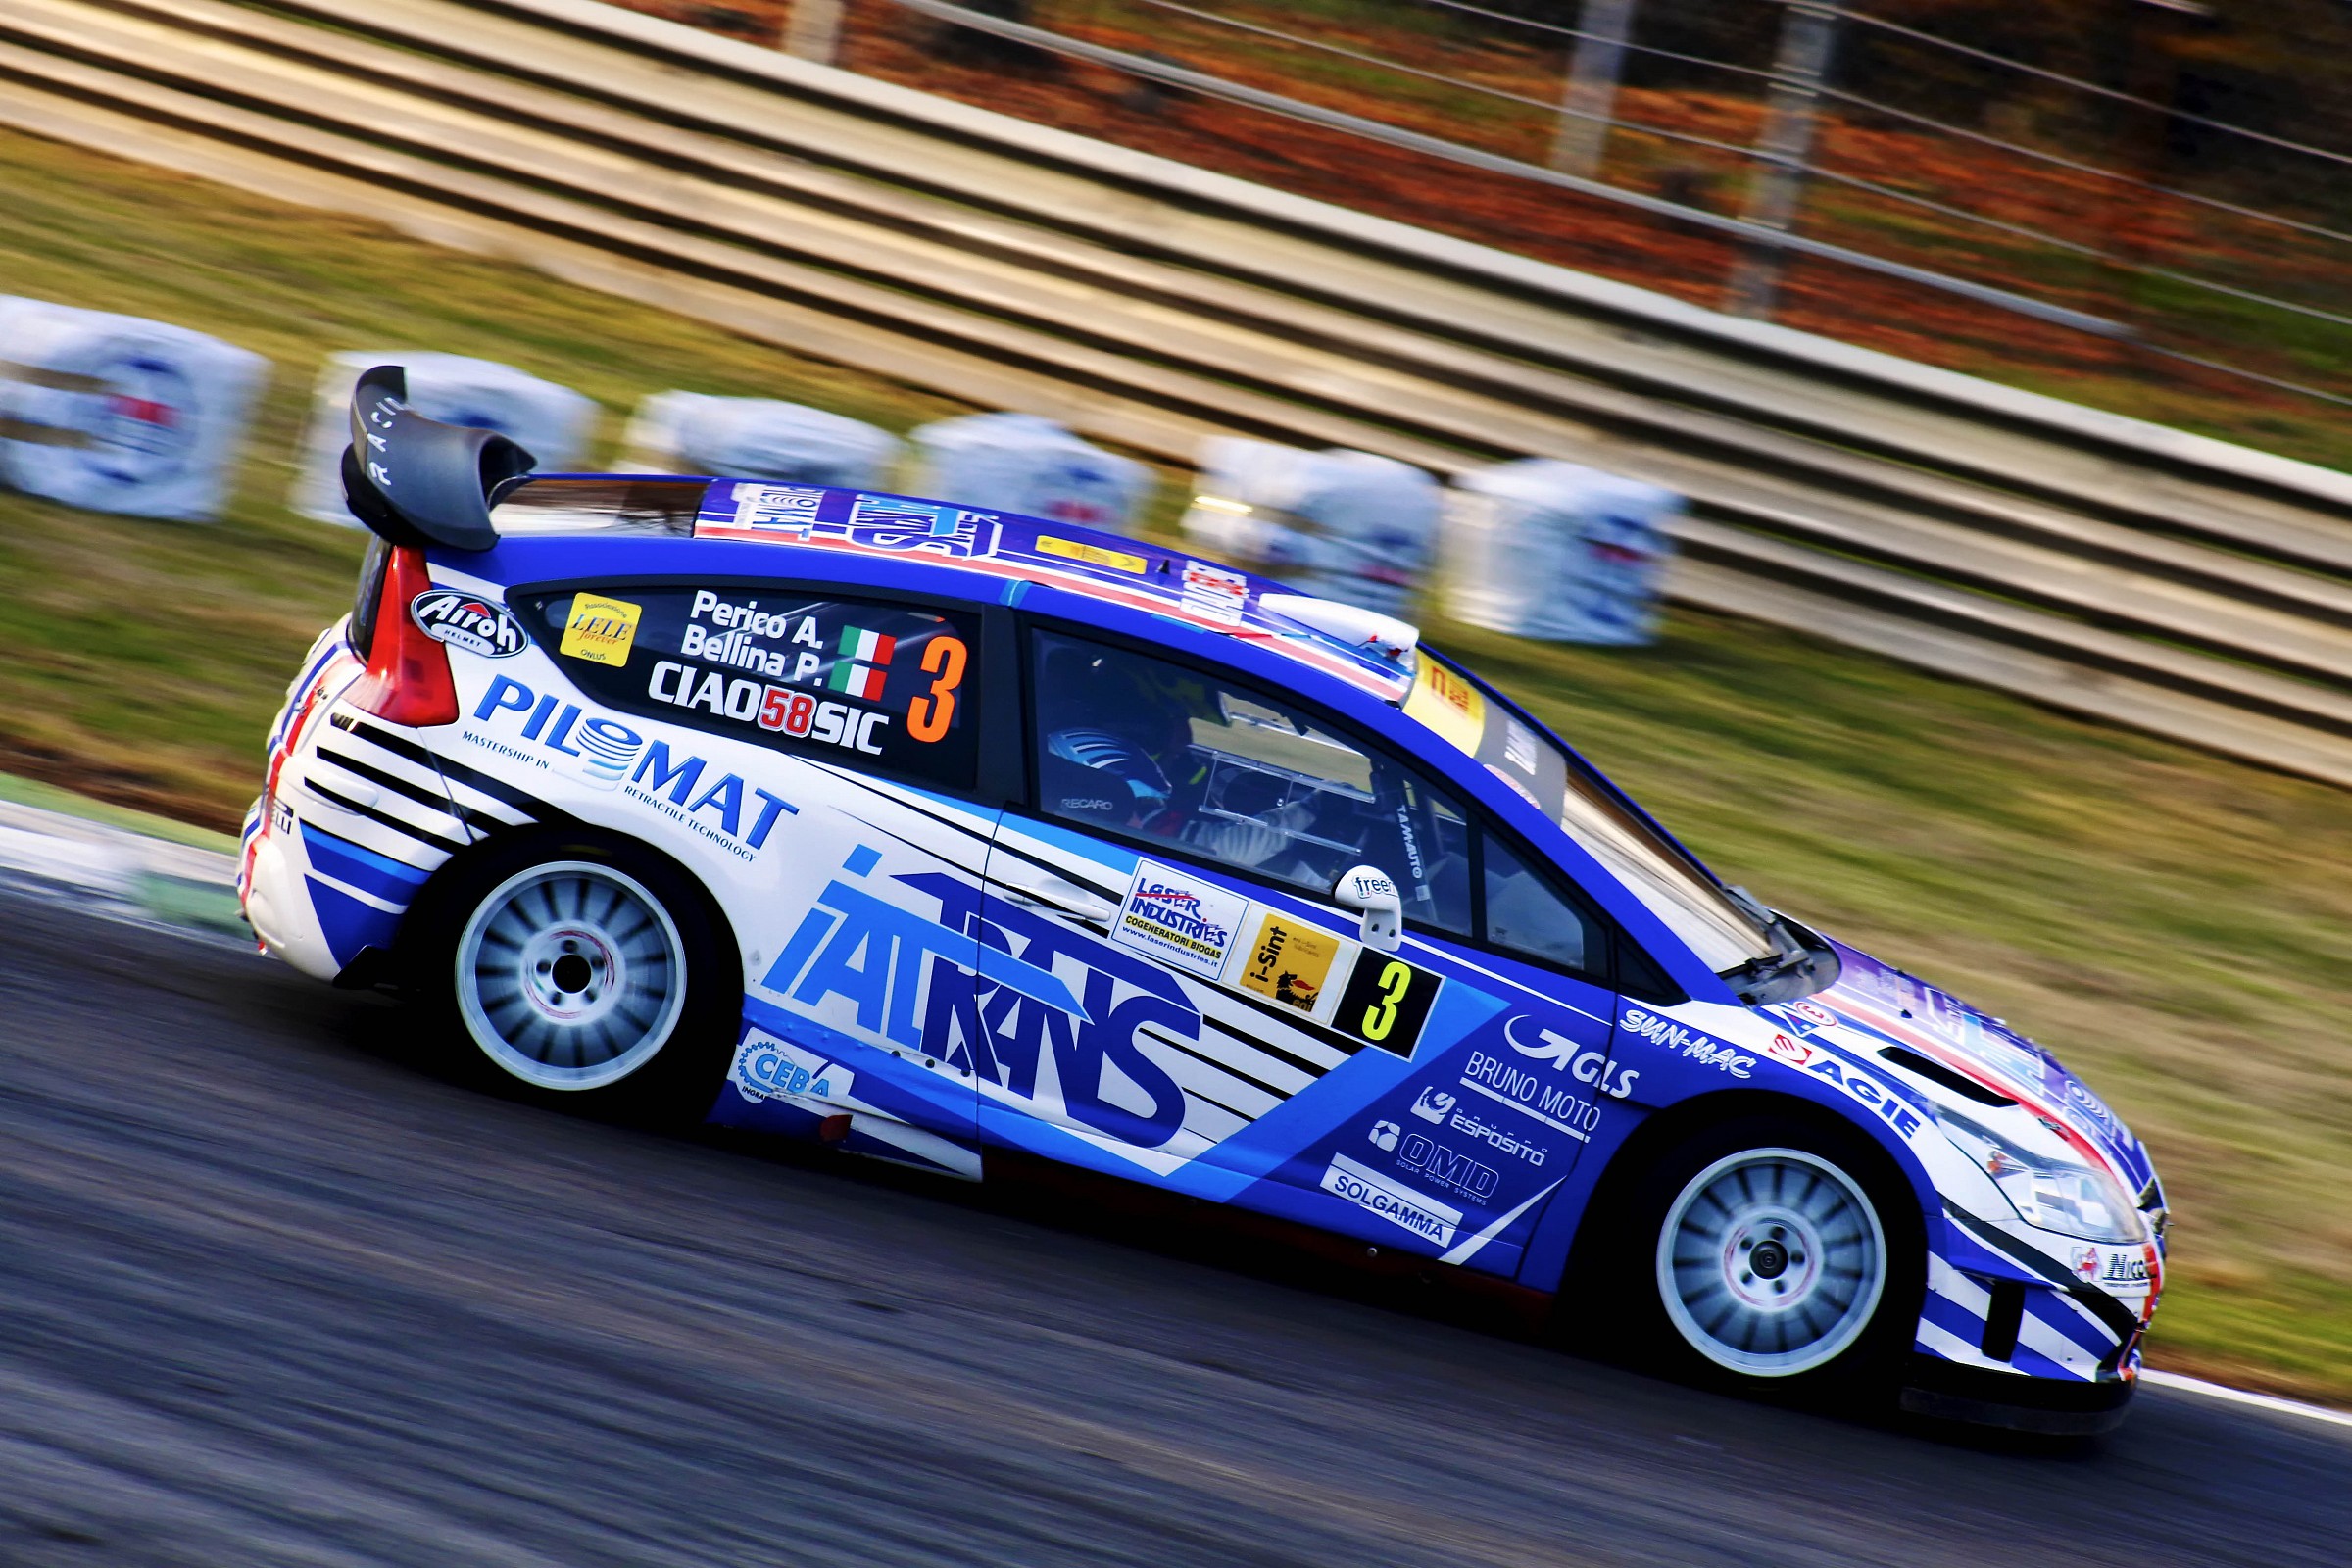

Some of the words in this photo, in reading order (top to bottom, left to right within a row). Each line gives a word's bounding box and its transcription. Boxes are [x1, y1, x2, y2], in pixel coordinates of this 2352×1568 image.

[418, 595, 517, 652] Airoh
[444, 629, 482, 647] HELMET
[571, 613, 632, 641] LELE
[690, 590, 786, 639] Perico
[792, 616, 823, 649] A.
[580, 648, 607, 661] ONLUS
[681, 624, 786, 677] Bellina
[794, 652, 823, 686] P.
[906, 635, 969, 743] 3
[462, 730, 534, 763] MASTERSHIP
[535, 759, 550, 770] IN
[473, 673, 800, 851] PILOMAT
[624, 785, 687, 823] RETRACTILE
[688, 817, 757, 862] TECHNOLOGY
[1060, 798, 1113, 811] RECARO
[1129, 896, 1228, 948] INDUSTRIES
[1136, 877, 1201, 921] LASER
[1122, 925, 1218, 968] www.laserindustries.it
[1125, 915, 1190, 948] COGENERATORI
[1190, 941, 1222, 960] BIOGAS
[1361, 961, 1411, 1041] 3
[1619, 1009, 1758, 1079] SUN-MAC
[755, 1054, 830, 1098] CEBA
[1464, 1051, 1538, 1102] BRUNO
[1538, 1085, 1601, 1132] MOTO
[1572, 1052, 1640, 1098] GLS
[1808, 1059, 1921, 1140] AGIE
[1399, 1133, 1499, 1199] OMD
[1449, 1113, 1546, 1167] ESPOSITO
[1334, 1175, 1444, 1241] SOLGAMMA
[1396, 1159, 1420, 1175] SOLAR
[1423, 1172, 1450, 1189] POWER
[1453, 1186, 1487, 1206] SYSTEMS
